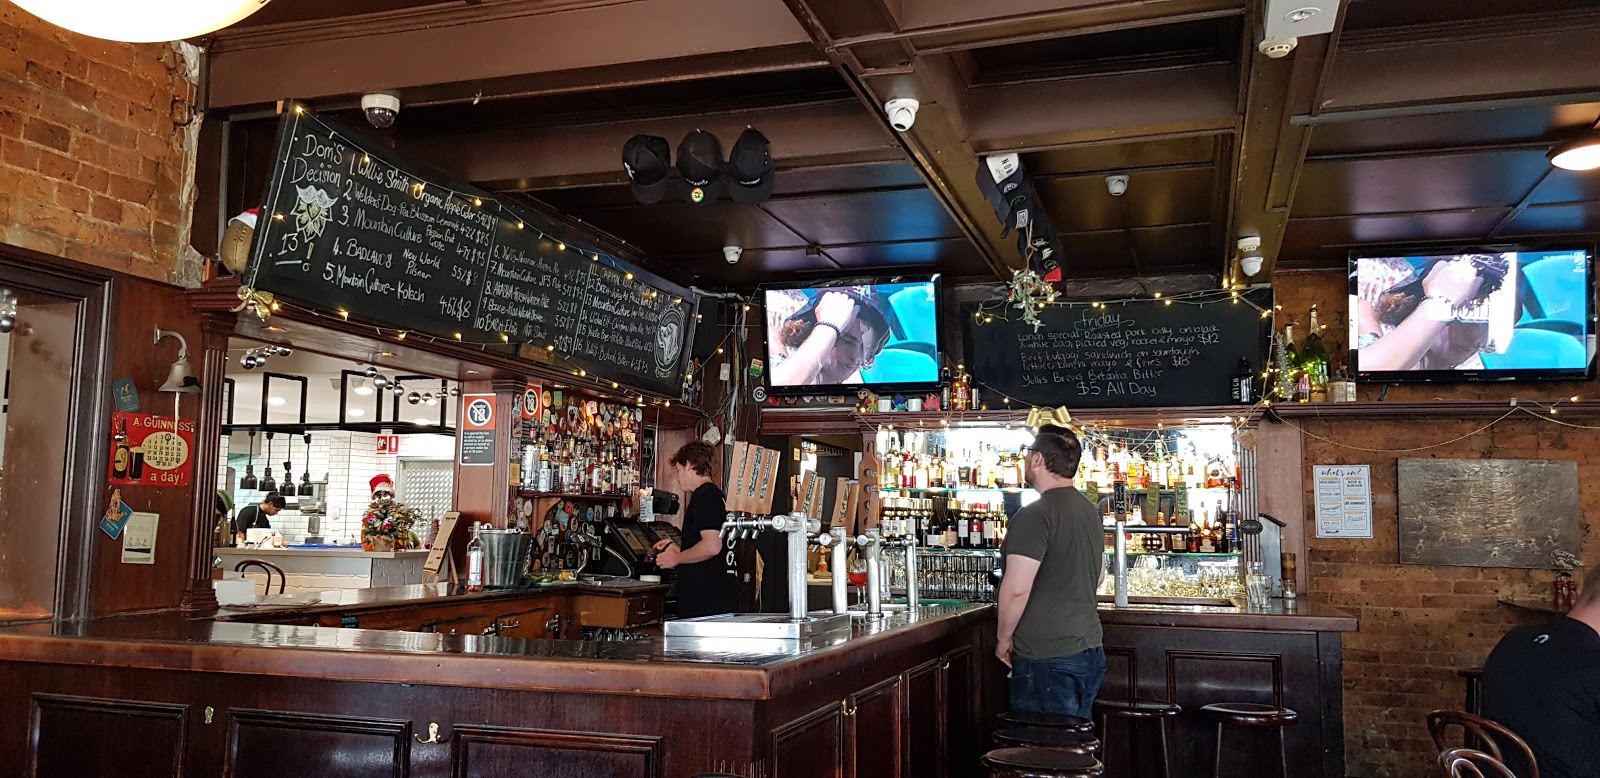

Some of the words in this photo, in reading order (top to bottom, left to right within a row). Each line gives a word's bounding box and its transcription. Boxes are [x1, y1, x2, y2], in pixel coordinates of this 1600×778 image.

[289, 157, 341, 188] Decision
[413, 183, 443, 209] Organic
[353, 208, 394, 237] Mountain
[394, 221, 423, 244] Culture
[403, 248, 418, 262] New
[420, 252, 441, 269] World
[336, 264, 366, 289] Mountain
[397, 280, 425, 302] Kolsch
[1084, 330, 1121, 341] Roasted
[1166, 335, 1195, 348] mayo
[1197, 333, 1220, 346] $12
[1084, 349, 1132, 360] sandwich
[1090, 360, 1117, 371] mayo
[1075, 380, 1102, 396] $5
[1107, 381, 1126, 397] All
[1128, 381, 1158, 397] Day
[472, 408, 486, 422] 18
[150, 472, 157, 481] a
[160, 471, 184, 485] day!
